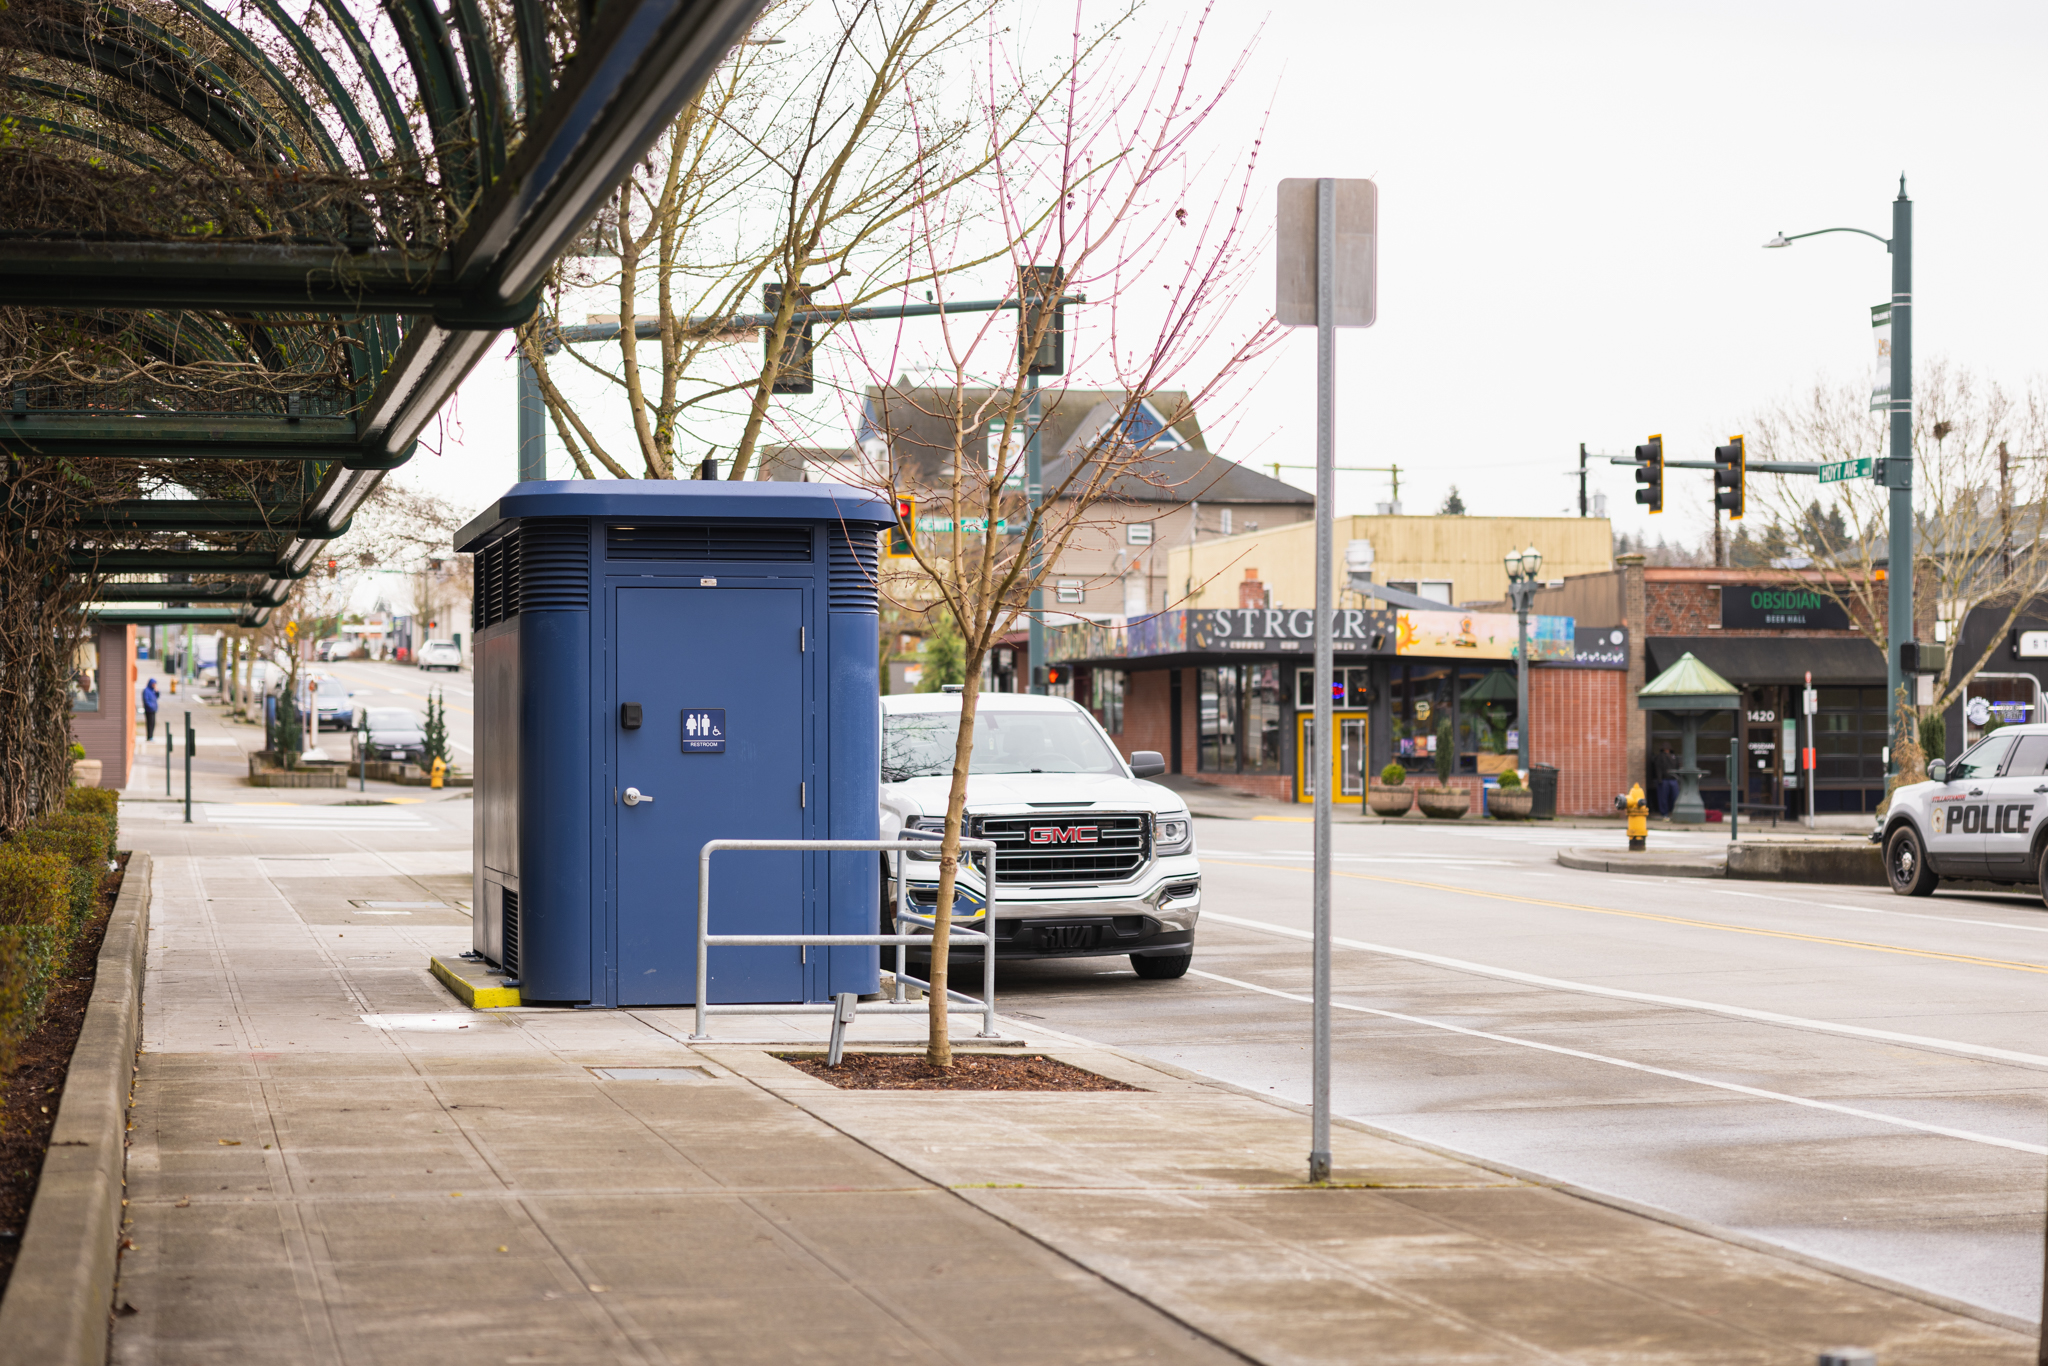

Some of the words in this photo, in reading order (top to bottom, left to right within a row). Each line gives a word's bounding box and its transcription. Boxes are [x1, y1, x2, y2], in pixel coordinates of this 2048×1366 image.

[1821, 463, 1842, 482] HOYT
[1843, 461, 1859, 478] AVE
[1750, 591, 1821, 610] OBSIDIAN
[1214, 609, 1367, 639] STRGR
[1765, 614, 1786, 624] BEER
[1787, 614, 1806, 624] HALL
[1747, 710, 1775, 722] 1420
[1946, 804, 2035, 834] POLICE
[1029, 825, 1099, 844] GMC
